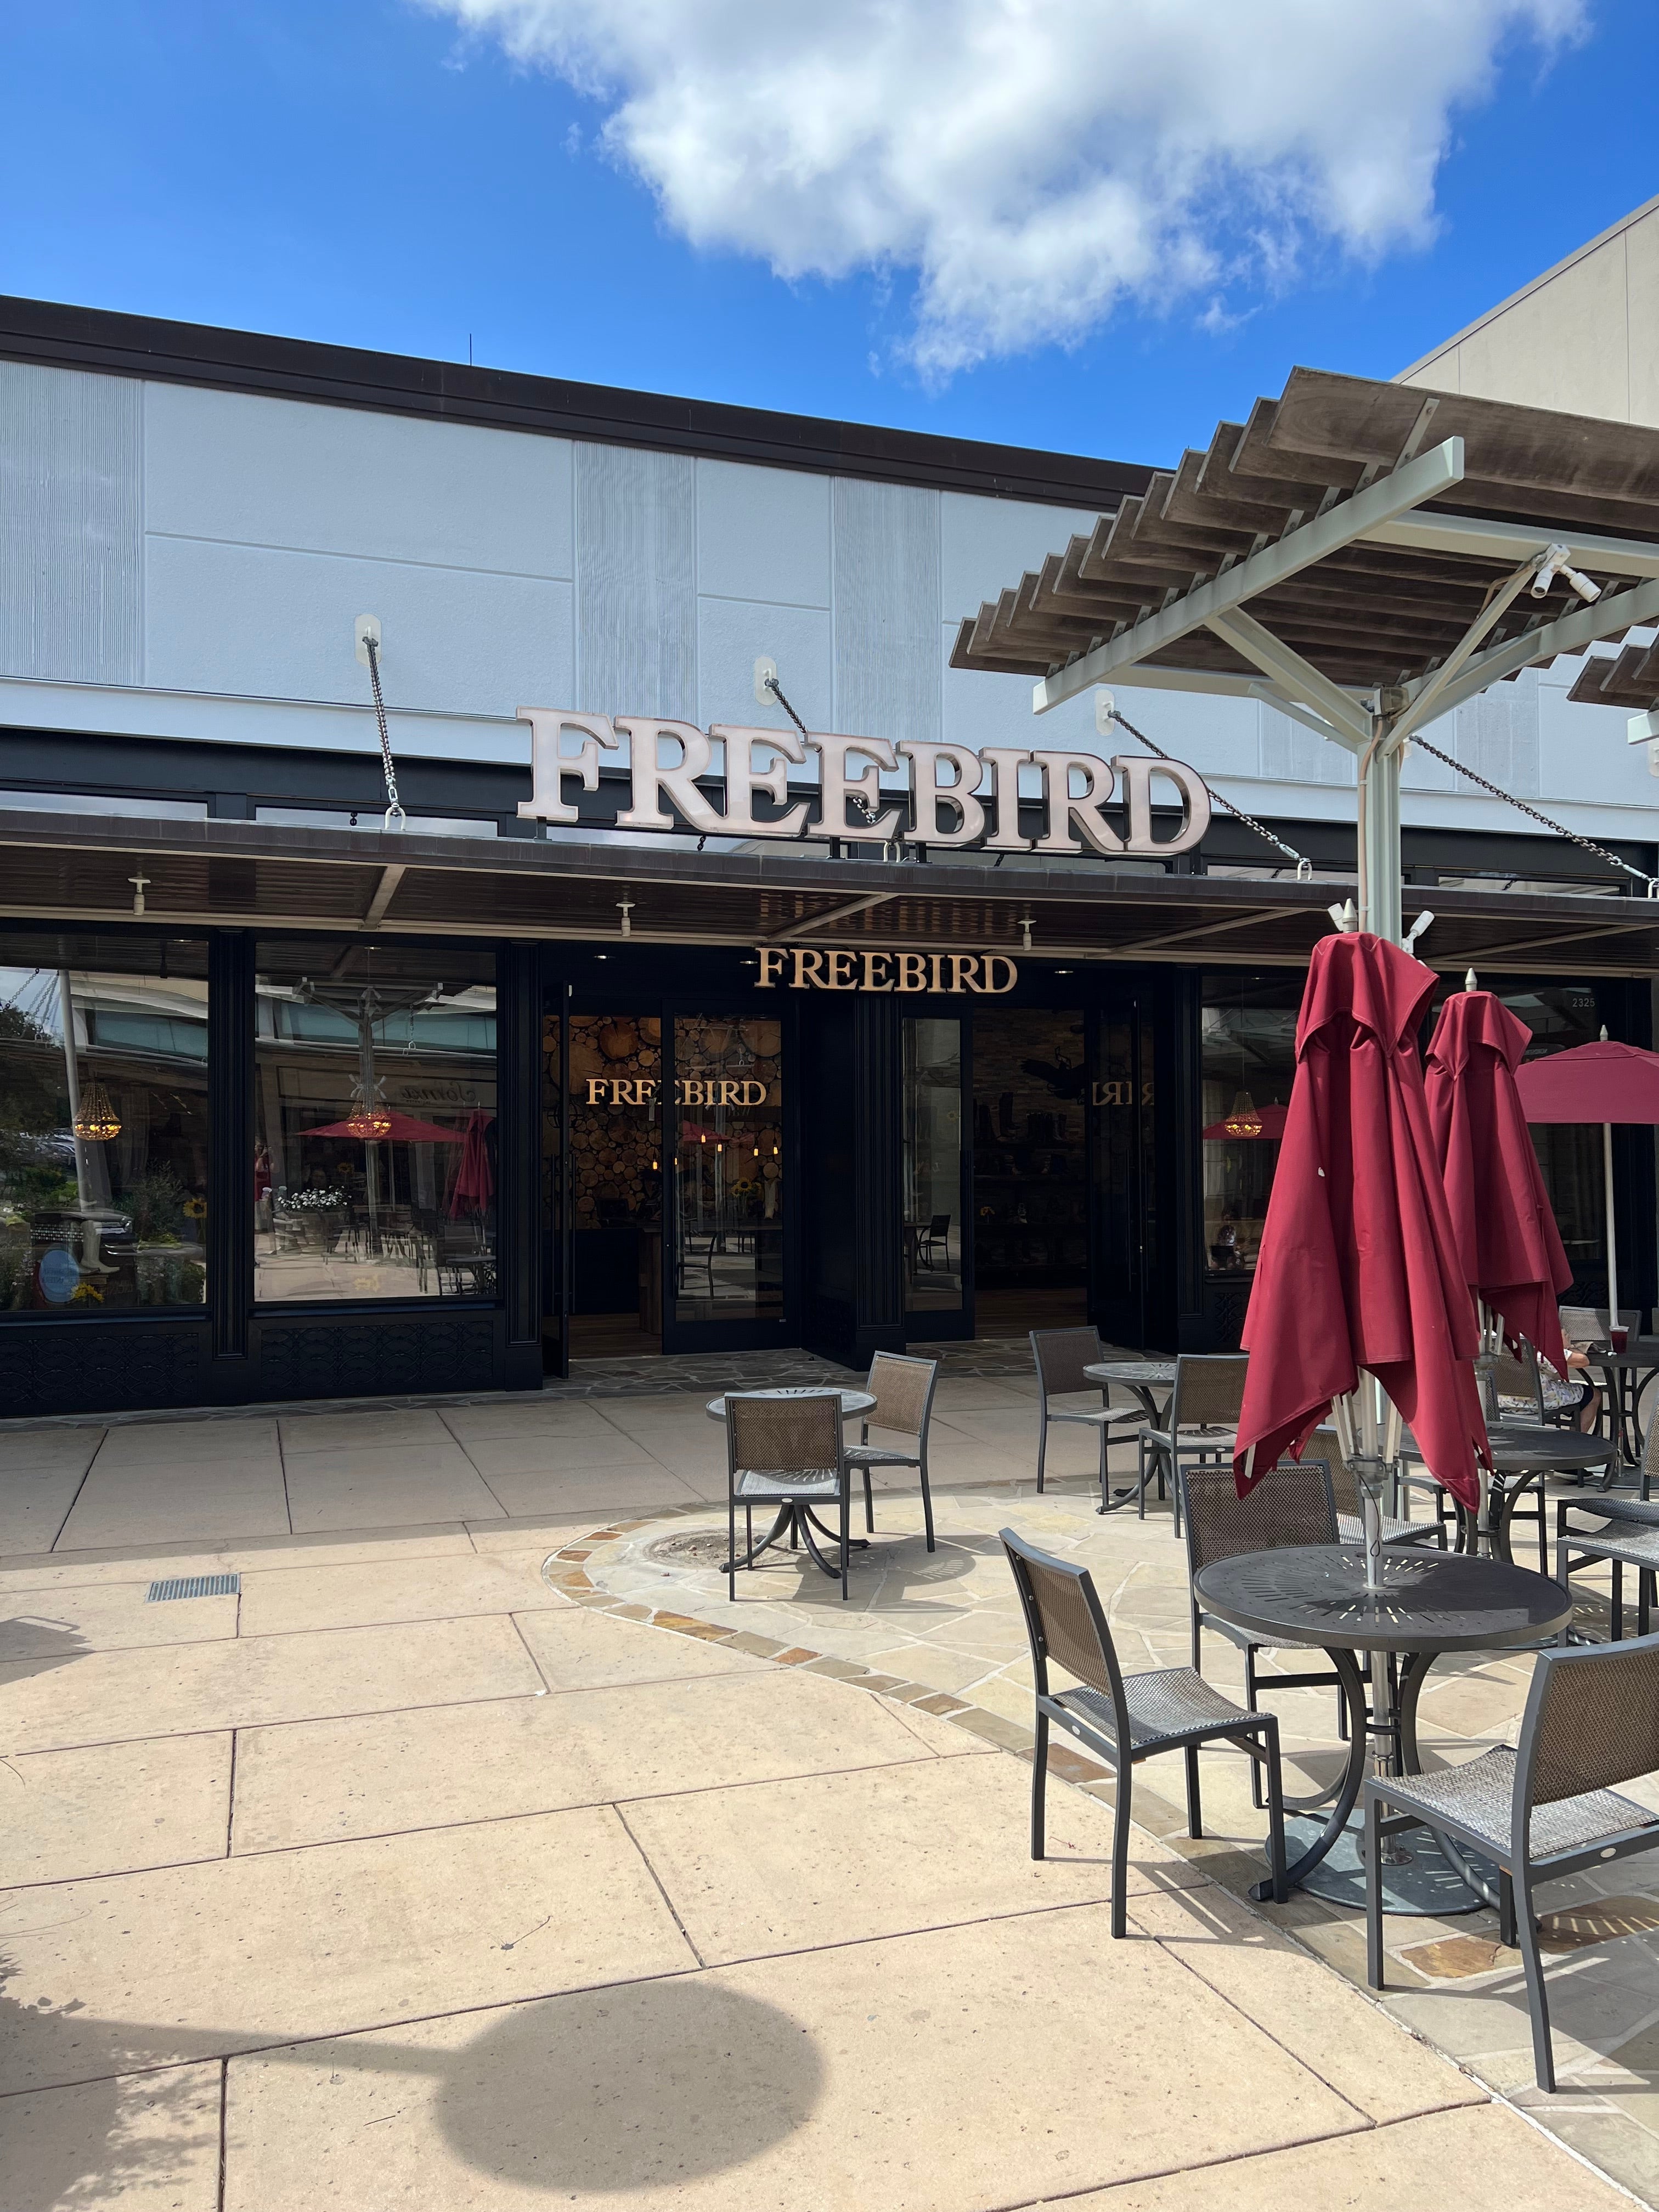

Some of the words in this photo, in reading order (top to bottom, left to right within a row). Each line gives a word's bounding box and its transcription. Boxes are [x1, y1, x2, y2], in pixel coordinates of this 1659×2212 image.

[516, 706, 1211, 856] FREEBIRD
[754, 947, 1018, 993] FREEBIRD
[1572, 998, 1595, 1007] 2325
